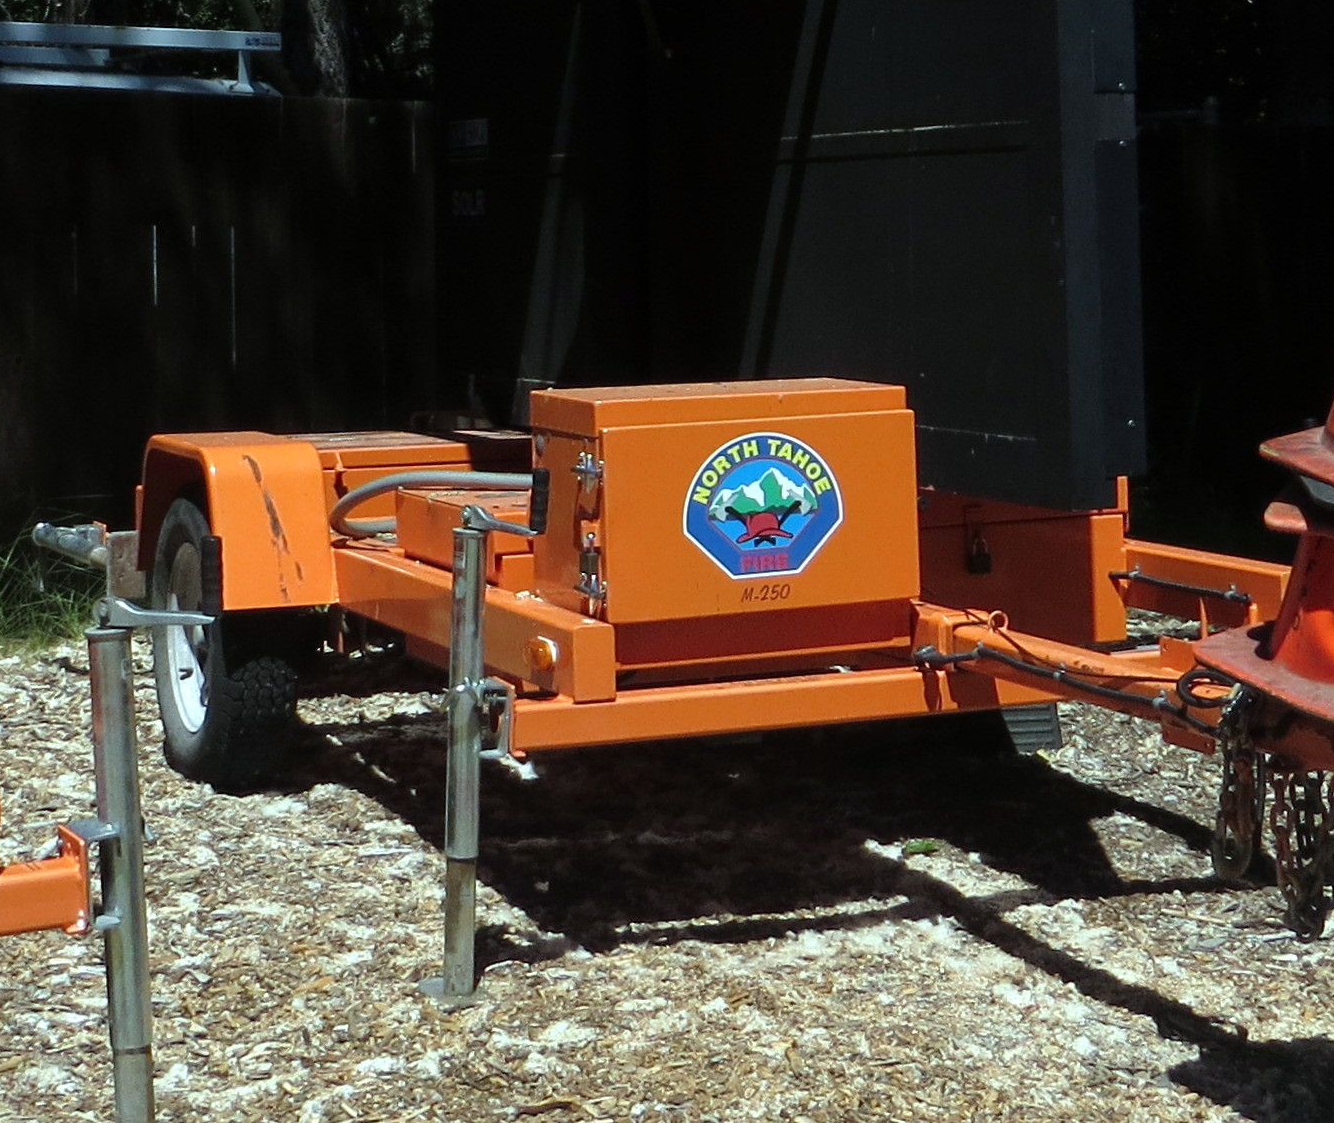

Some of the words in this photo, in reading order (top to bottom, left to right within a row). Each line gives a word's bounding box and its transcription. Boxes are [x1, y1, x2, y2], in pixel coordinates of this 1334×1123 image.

[692, 440, 759, 504] NORTH
[768, 438, 832, 495] TAHOE
[740, 553, 790, 571] FIRE
[741, 584, 791, 603] M-250
